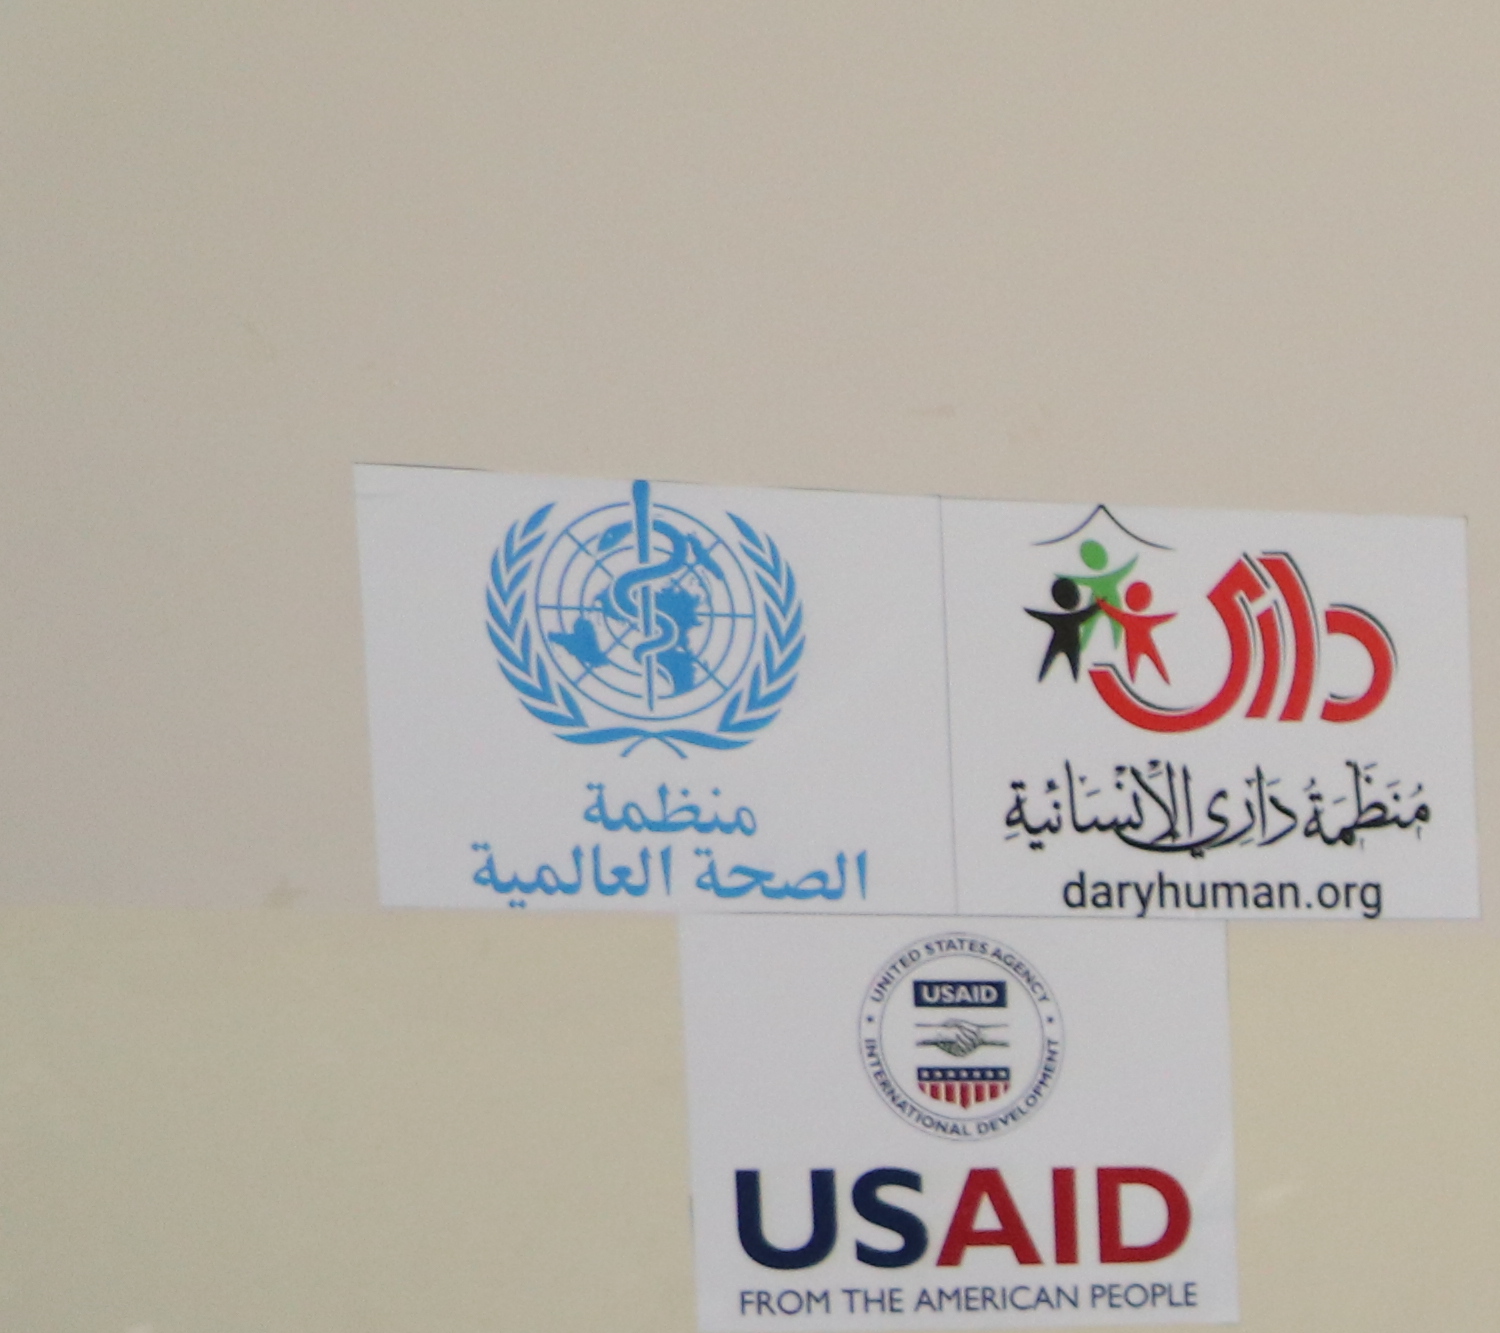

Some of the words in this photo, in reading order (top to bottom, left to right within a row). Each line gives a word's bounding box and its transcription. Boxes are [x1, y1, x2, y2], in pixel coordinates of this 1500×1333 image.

[584, 782, 757, 836] منظمة
[472, 842, 671, 908] العالمية
[694, 847, 867, 901] الصحة
[1062, 870, 1383, 918] daryhuman.org
[870, 949, 921, 1003] UNITED
[924, 937, 990, 956] STATES
[990, 948, 1049, 1003] AGENCY
[922, 984, 999, 1004] USAID
[865, 1038, 971, 1136] INTERNATIONAL
[977, 1039, 1059, 1135] DEVELOPMENT
[734, 1166, 1192, 1270] USAID
[740, 1289, 831, 1316] FROM
[842, 1287, 904, 1314] THE
[914, 1284, 1079, 1313] AMERICAN
[1090, 1281, 1198, 1310] PEOPLE
